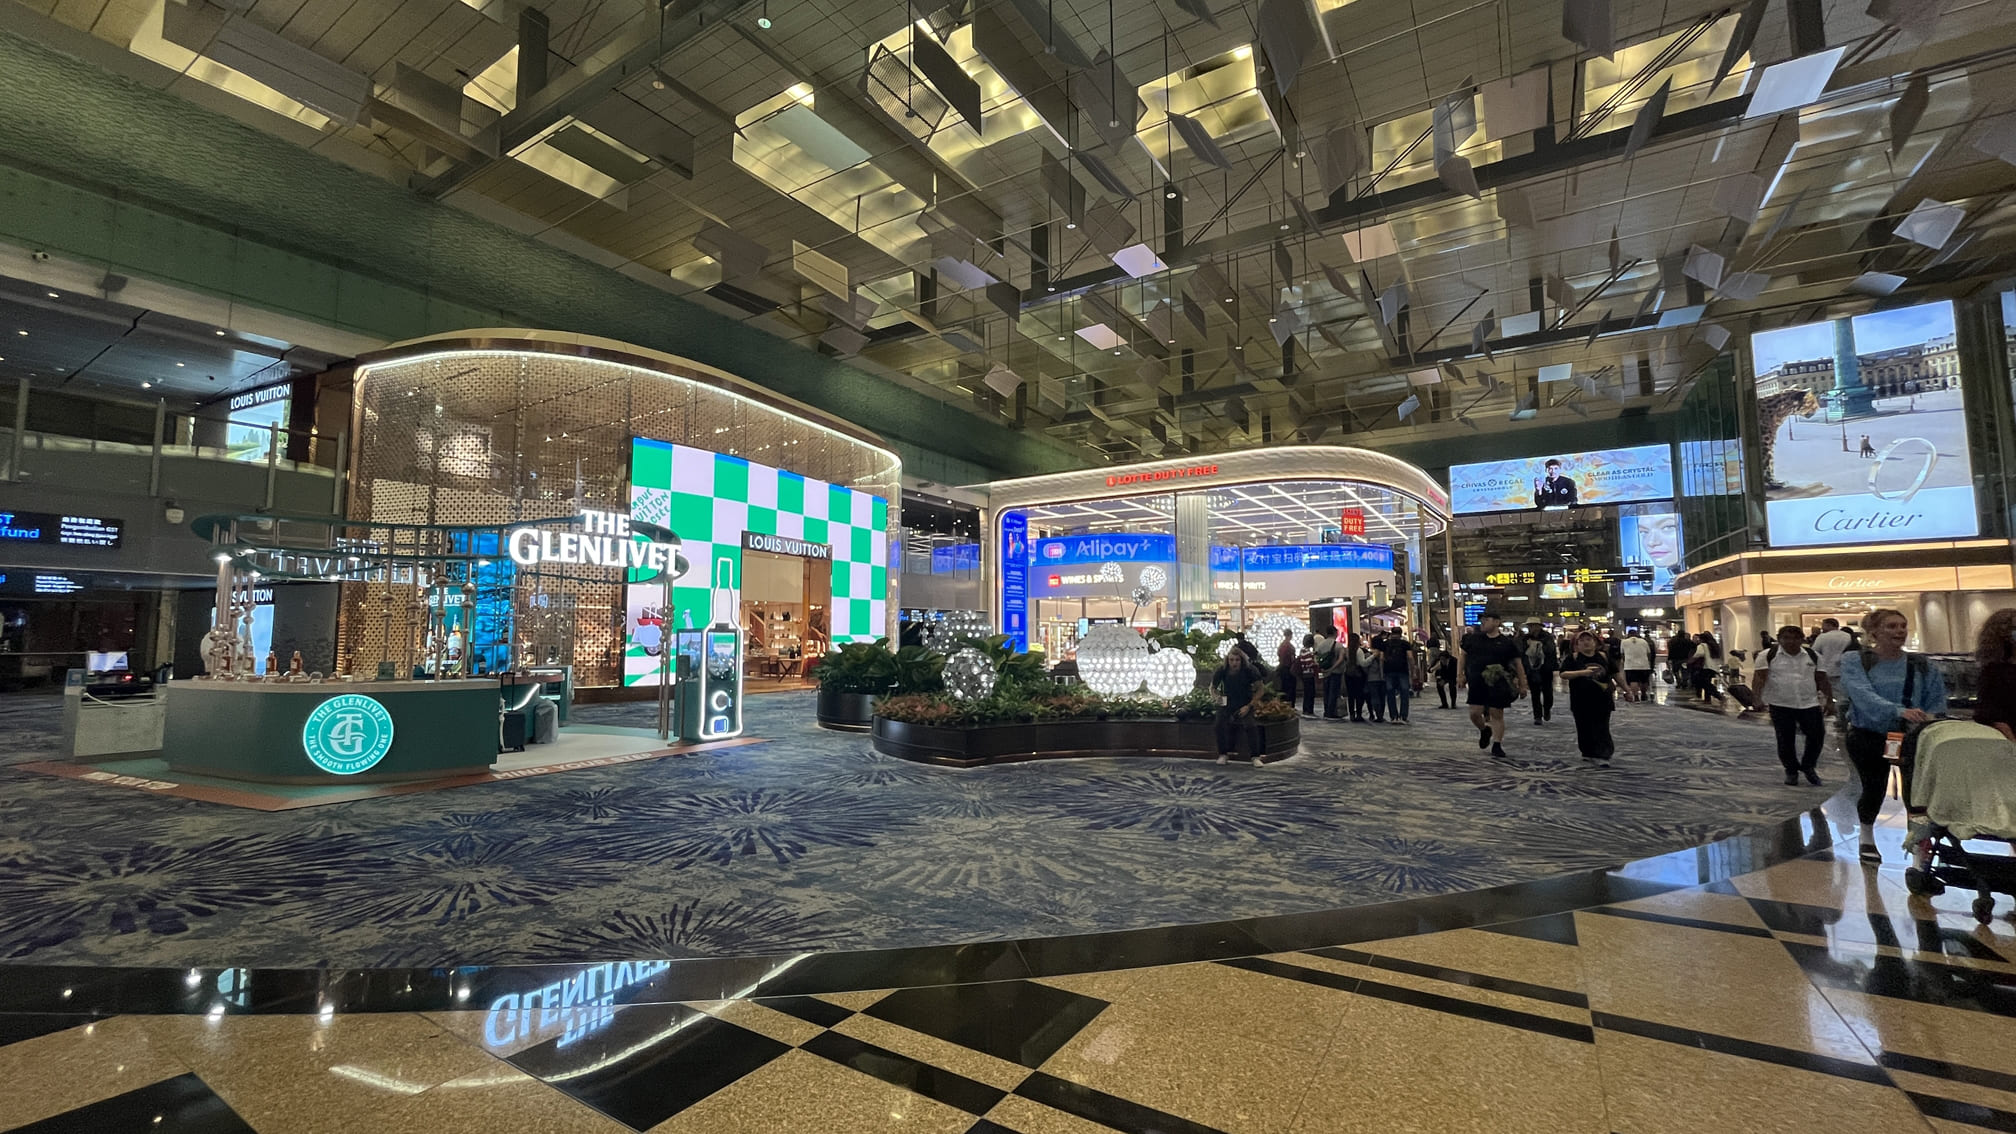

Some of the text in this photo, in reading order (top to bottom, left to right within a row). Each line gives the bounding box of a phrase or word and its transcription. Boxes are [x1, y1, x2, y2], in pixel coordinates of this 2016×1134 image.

[230, 383, 291, 410] LOUIS VUITTON
[1118, 464, 1218, 484] LOTTE DUTY FREE
[580, 508, 631, 537] THE
[1343, 517, 1362, 525] DUTY
[1343, 525, 1363, 533] FREE
[1814, 508, 1923, 532] Cartier
[509, 528, 682, 577] GLENLIVET
[750, 535, 827, 557] LOUIS VUITTON
[1828, 575, 1886, 589] Cartier
[312, 698, 387, 723] THE GLENLIVET
[314, 750, 344, 770] SMOOTH
[346, 750, 380, 770] FLOWING
[378, 734, 389, 749] ONE
[492, 766, 549, 780] MIND
[551, 758, 606, 771] YOUR
